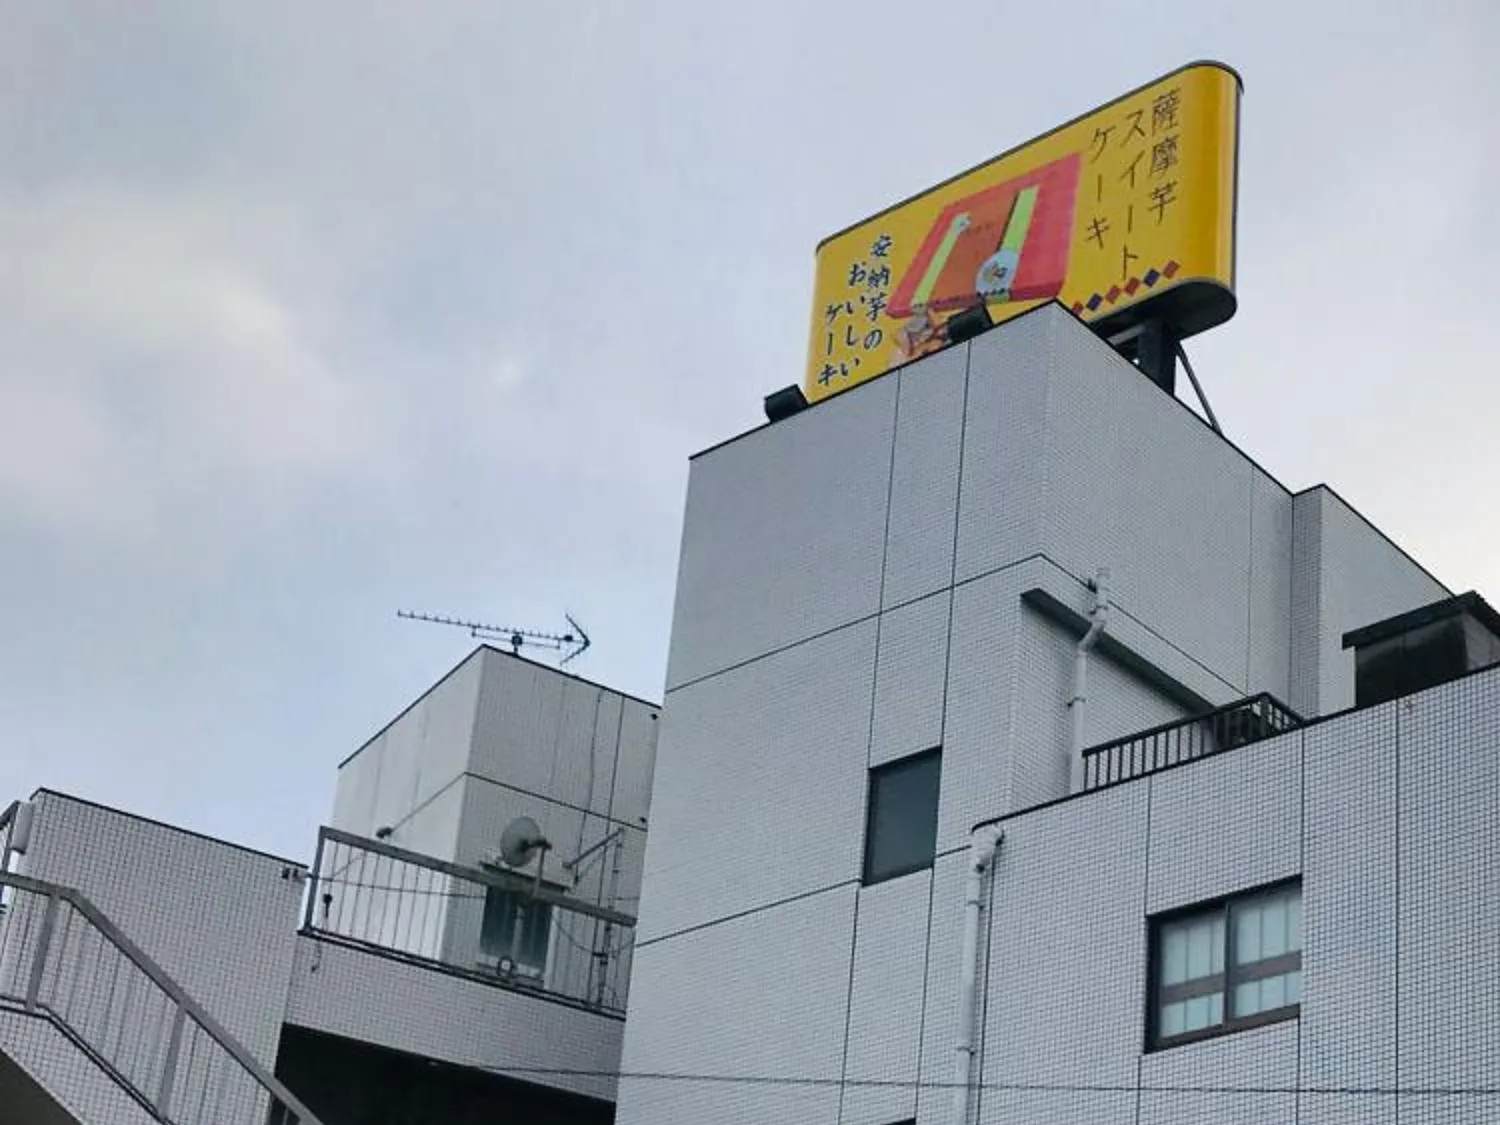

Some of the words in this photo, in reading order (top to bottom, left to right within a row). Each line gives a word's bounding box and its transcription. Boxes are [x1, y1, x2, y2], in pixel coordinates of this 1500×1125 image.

[1085, 125, 1117, 250] ケーキ
[1119, 109, 1146, 281] スイート
[1149, 88, 1181, 225] 薩摩芋
[817, 303, 844, 387] ケーキ
[839, 261, 867, 377] おいしい
